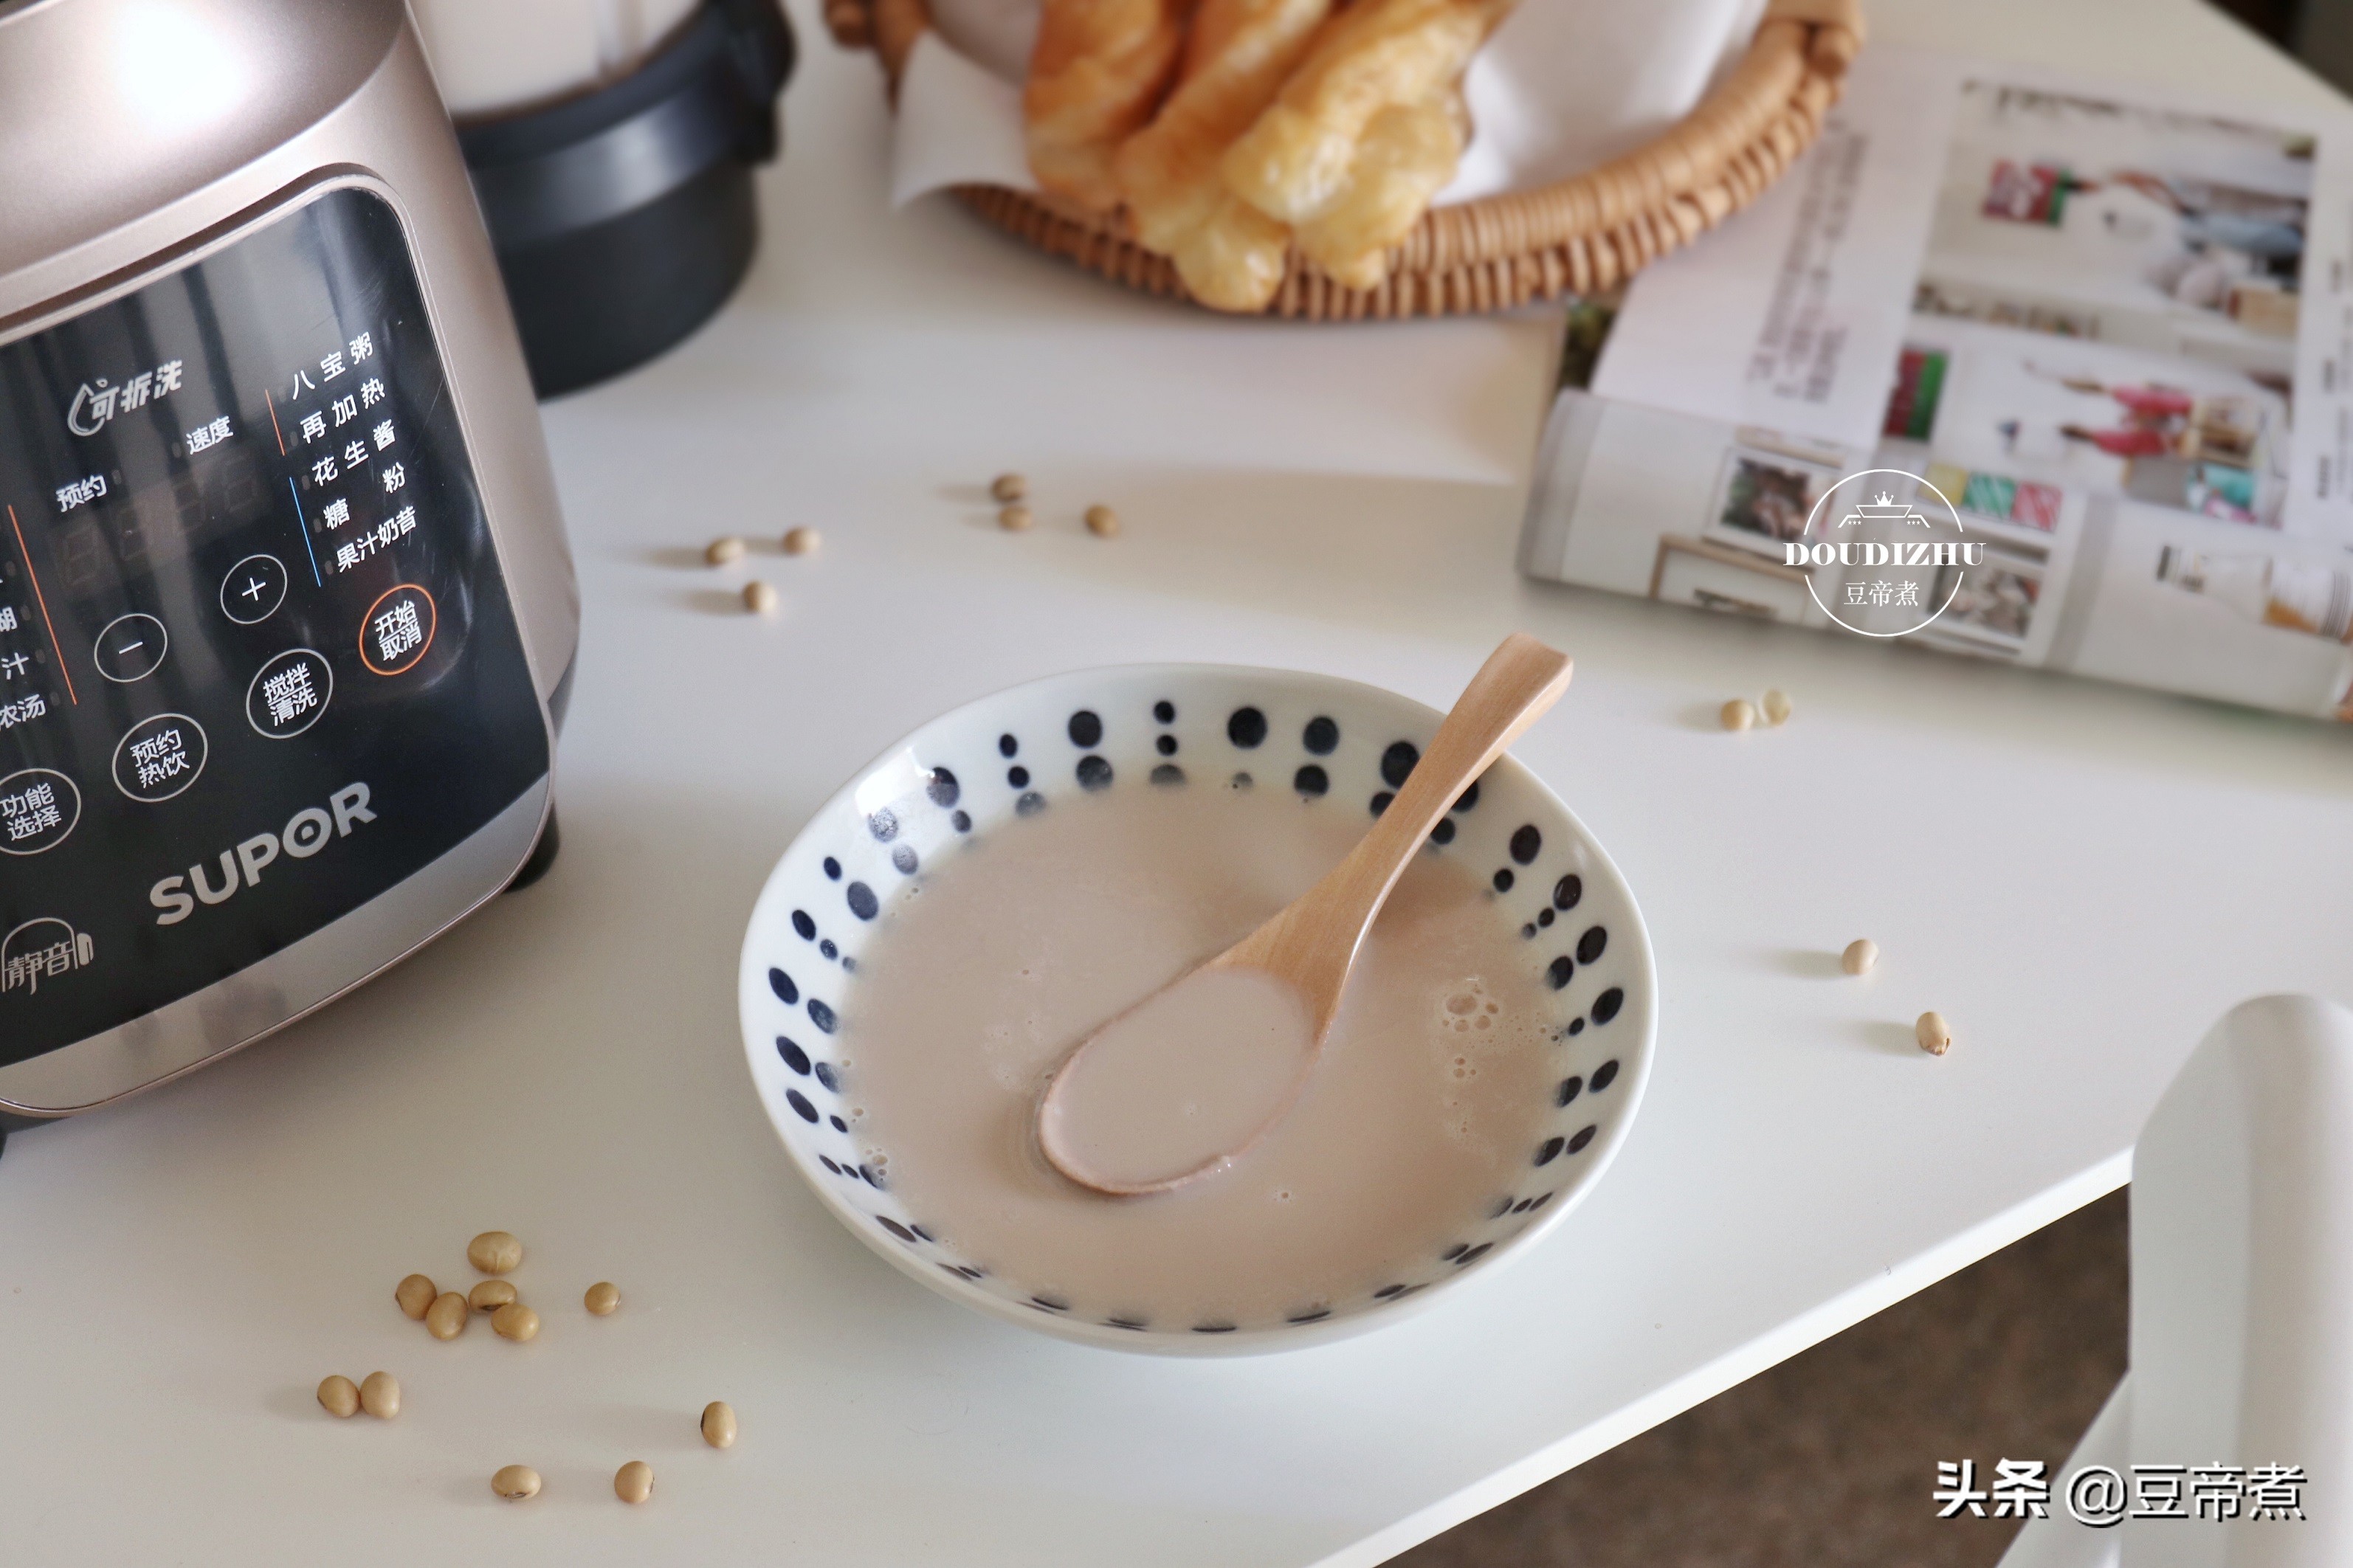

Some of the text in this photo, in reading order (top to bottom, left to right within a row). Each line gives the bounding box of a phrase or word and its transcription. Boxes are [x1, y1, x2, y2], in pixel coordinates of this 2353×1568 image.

[292, 331, 373, 400] 八宝粥
[300, 378, 385, 443] 再加热
[186, 415, 234, 455] 速度
[311, 418, 396, 486] 花生酱
[55, 474, 108, 513] 预约
[336, 505, 417, 573] 果汁奶昔
[374, 600, 417, 640] 开始
[379, 621, 422, 661] 取消
[263, 662, 311, 703] 搅拌
[269, 685, 317, 727] 清洗
[129, 728, 182, 767] 预约
[138, 750, 190, 789] 热饮
[0, 782, 55, 818] 功能
[7, 804, 62, 841] 选择
[149, 781, 377, 925] SUPOR
[4, 941, 73, 995] 静音
